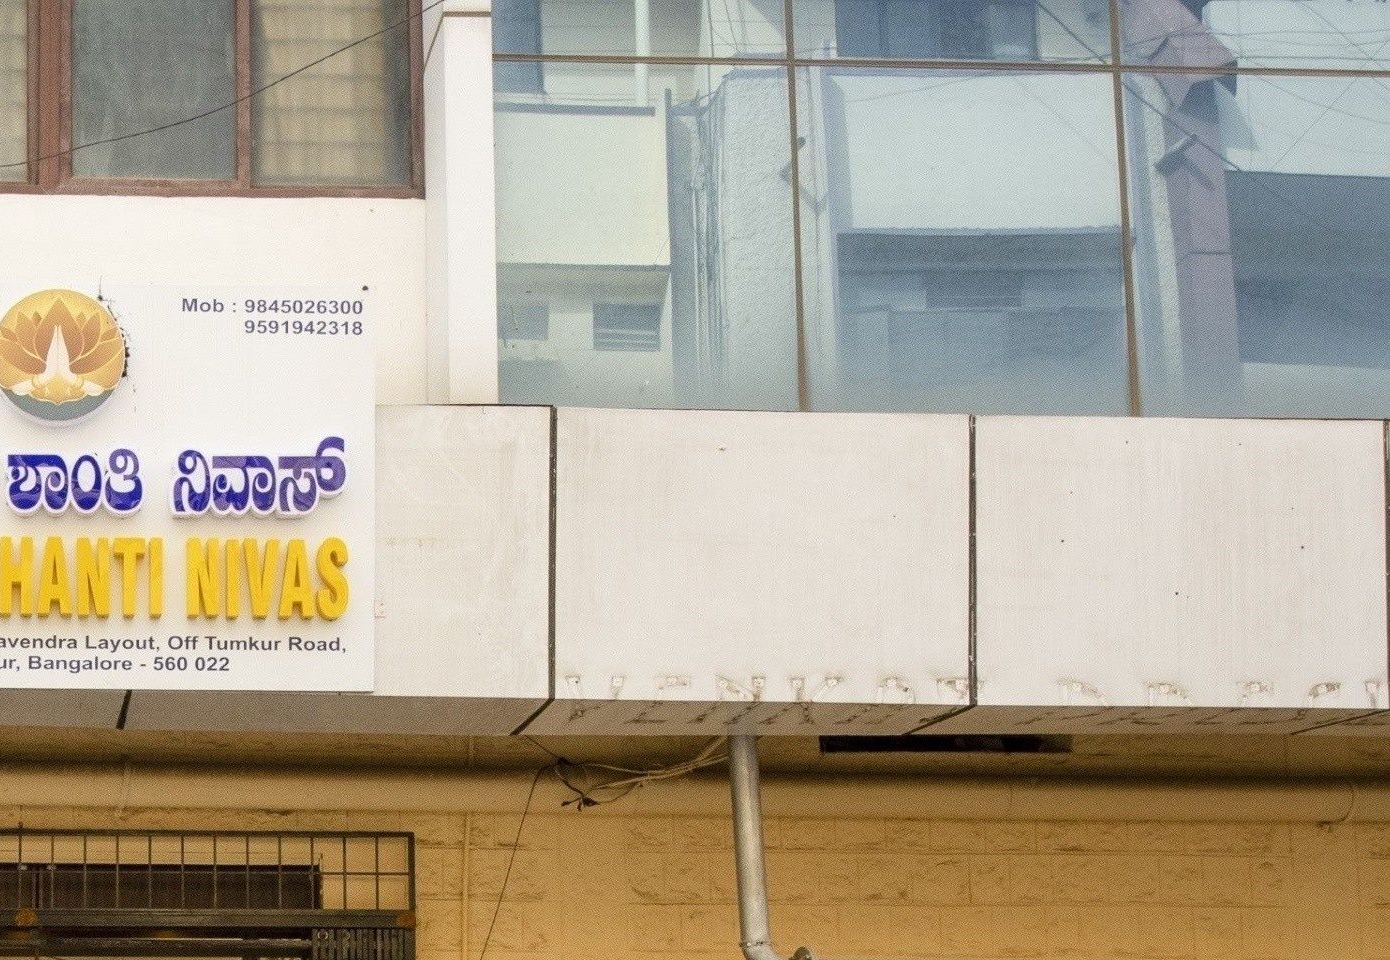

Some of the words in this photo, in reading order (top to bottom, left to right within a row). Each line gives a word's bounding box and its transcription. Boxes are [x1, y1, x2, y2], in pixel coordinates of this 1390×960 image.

[181, 298, 224, 313] Mob
[244, 299, 364, 315] 9845026300
[244, 320, 364, 336] 9591942318
[7, 448, 143, 511] ಶಾಂತಿ
[173, 436, 347, 513] ನಿವಾಸ್
[186, 537, 350, 621] NIVAS
[85, 635, 160, 653] Layout,
[168, 635, 199, 650] Off
[205, 636, 281, 651] Tumkur
[288, 636, 347, 653] Road,
[28, 655, 133, 673] Bangalore
[153, 657, 188, 671] 560
[195, 657, 230, 671] 022
